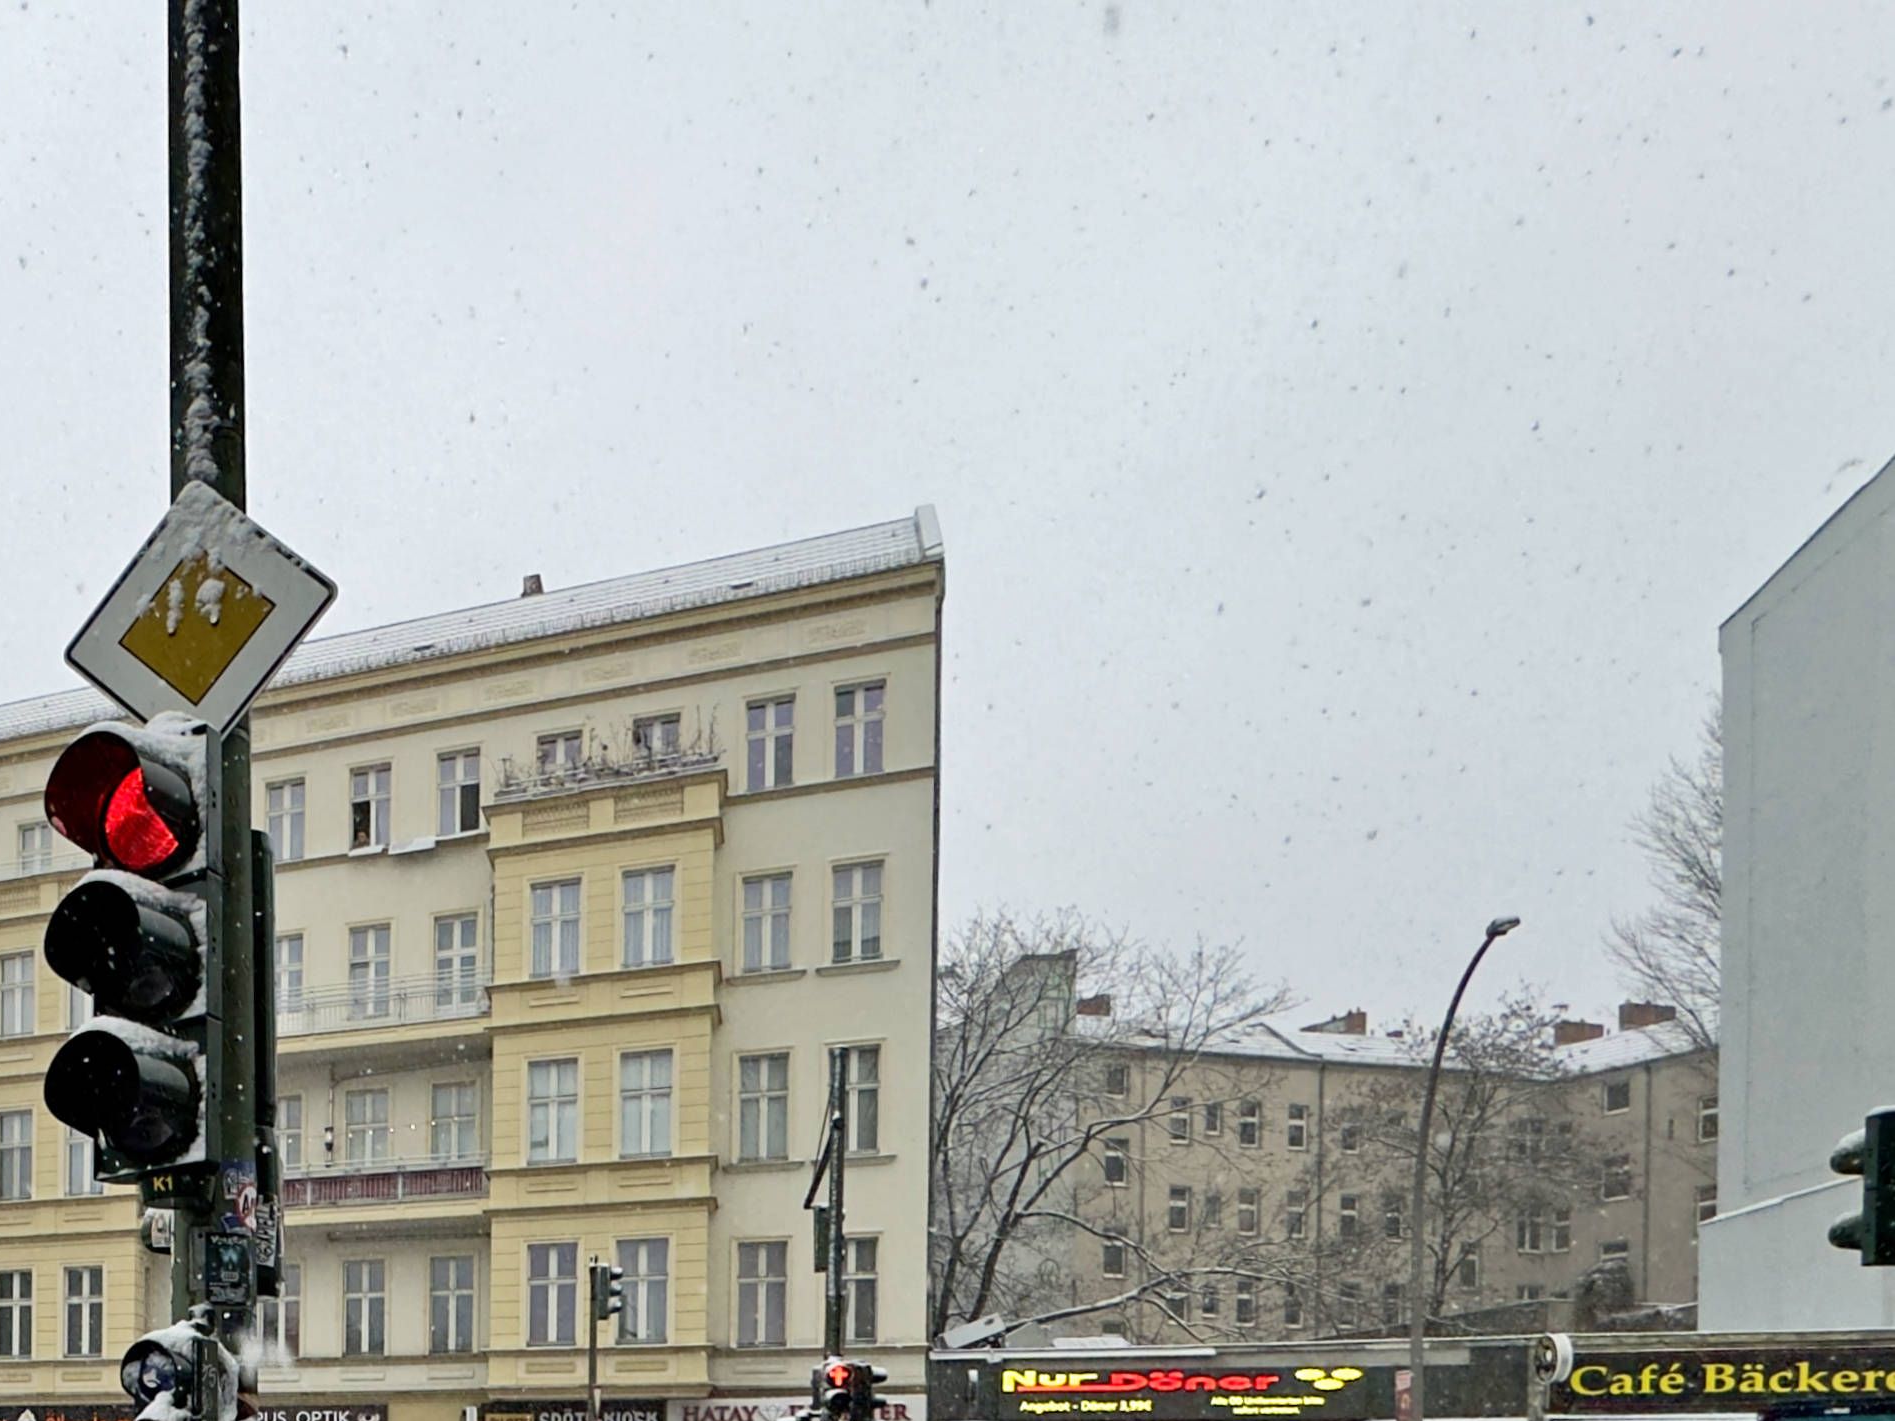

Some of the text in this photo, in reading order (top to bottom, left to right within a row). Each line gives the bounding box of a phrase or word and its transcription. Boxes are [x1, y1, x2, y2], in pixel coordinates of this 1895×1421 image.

[153, 1176, 174, 1191] K1
[1002, 1369, 1280, 1393] Nur Döner
[1570, 1363, 1685, 1395] Café
[1019, 1400, 1071, 1415] Angebot
